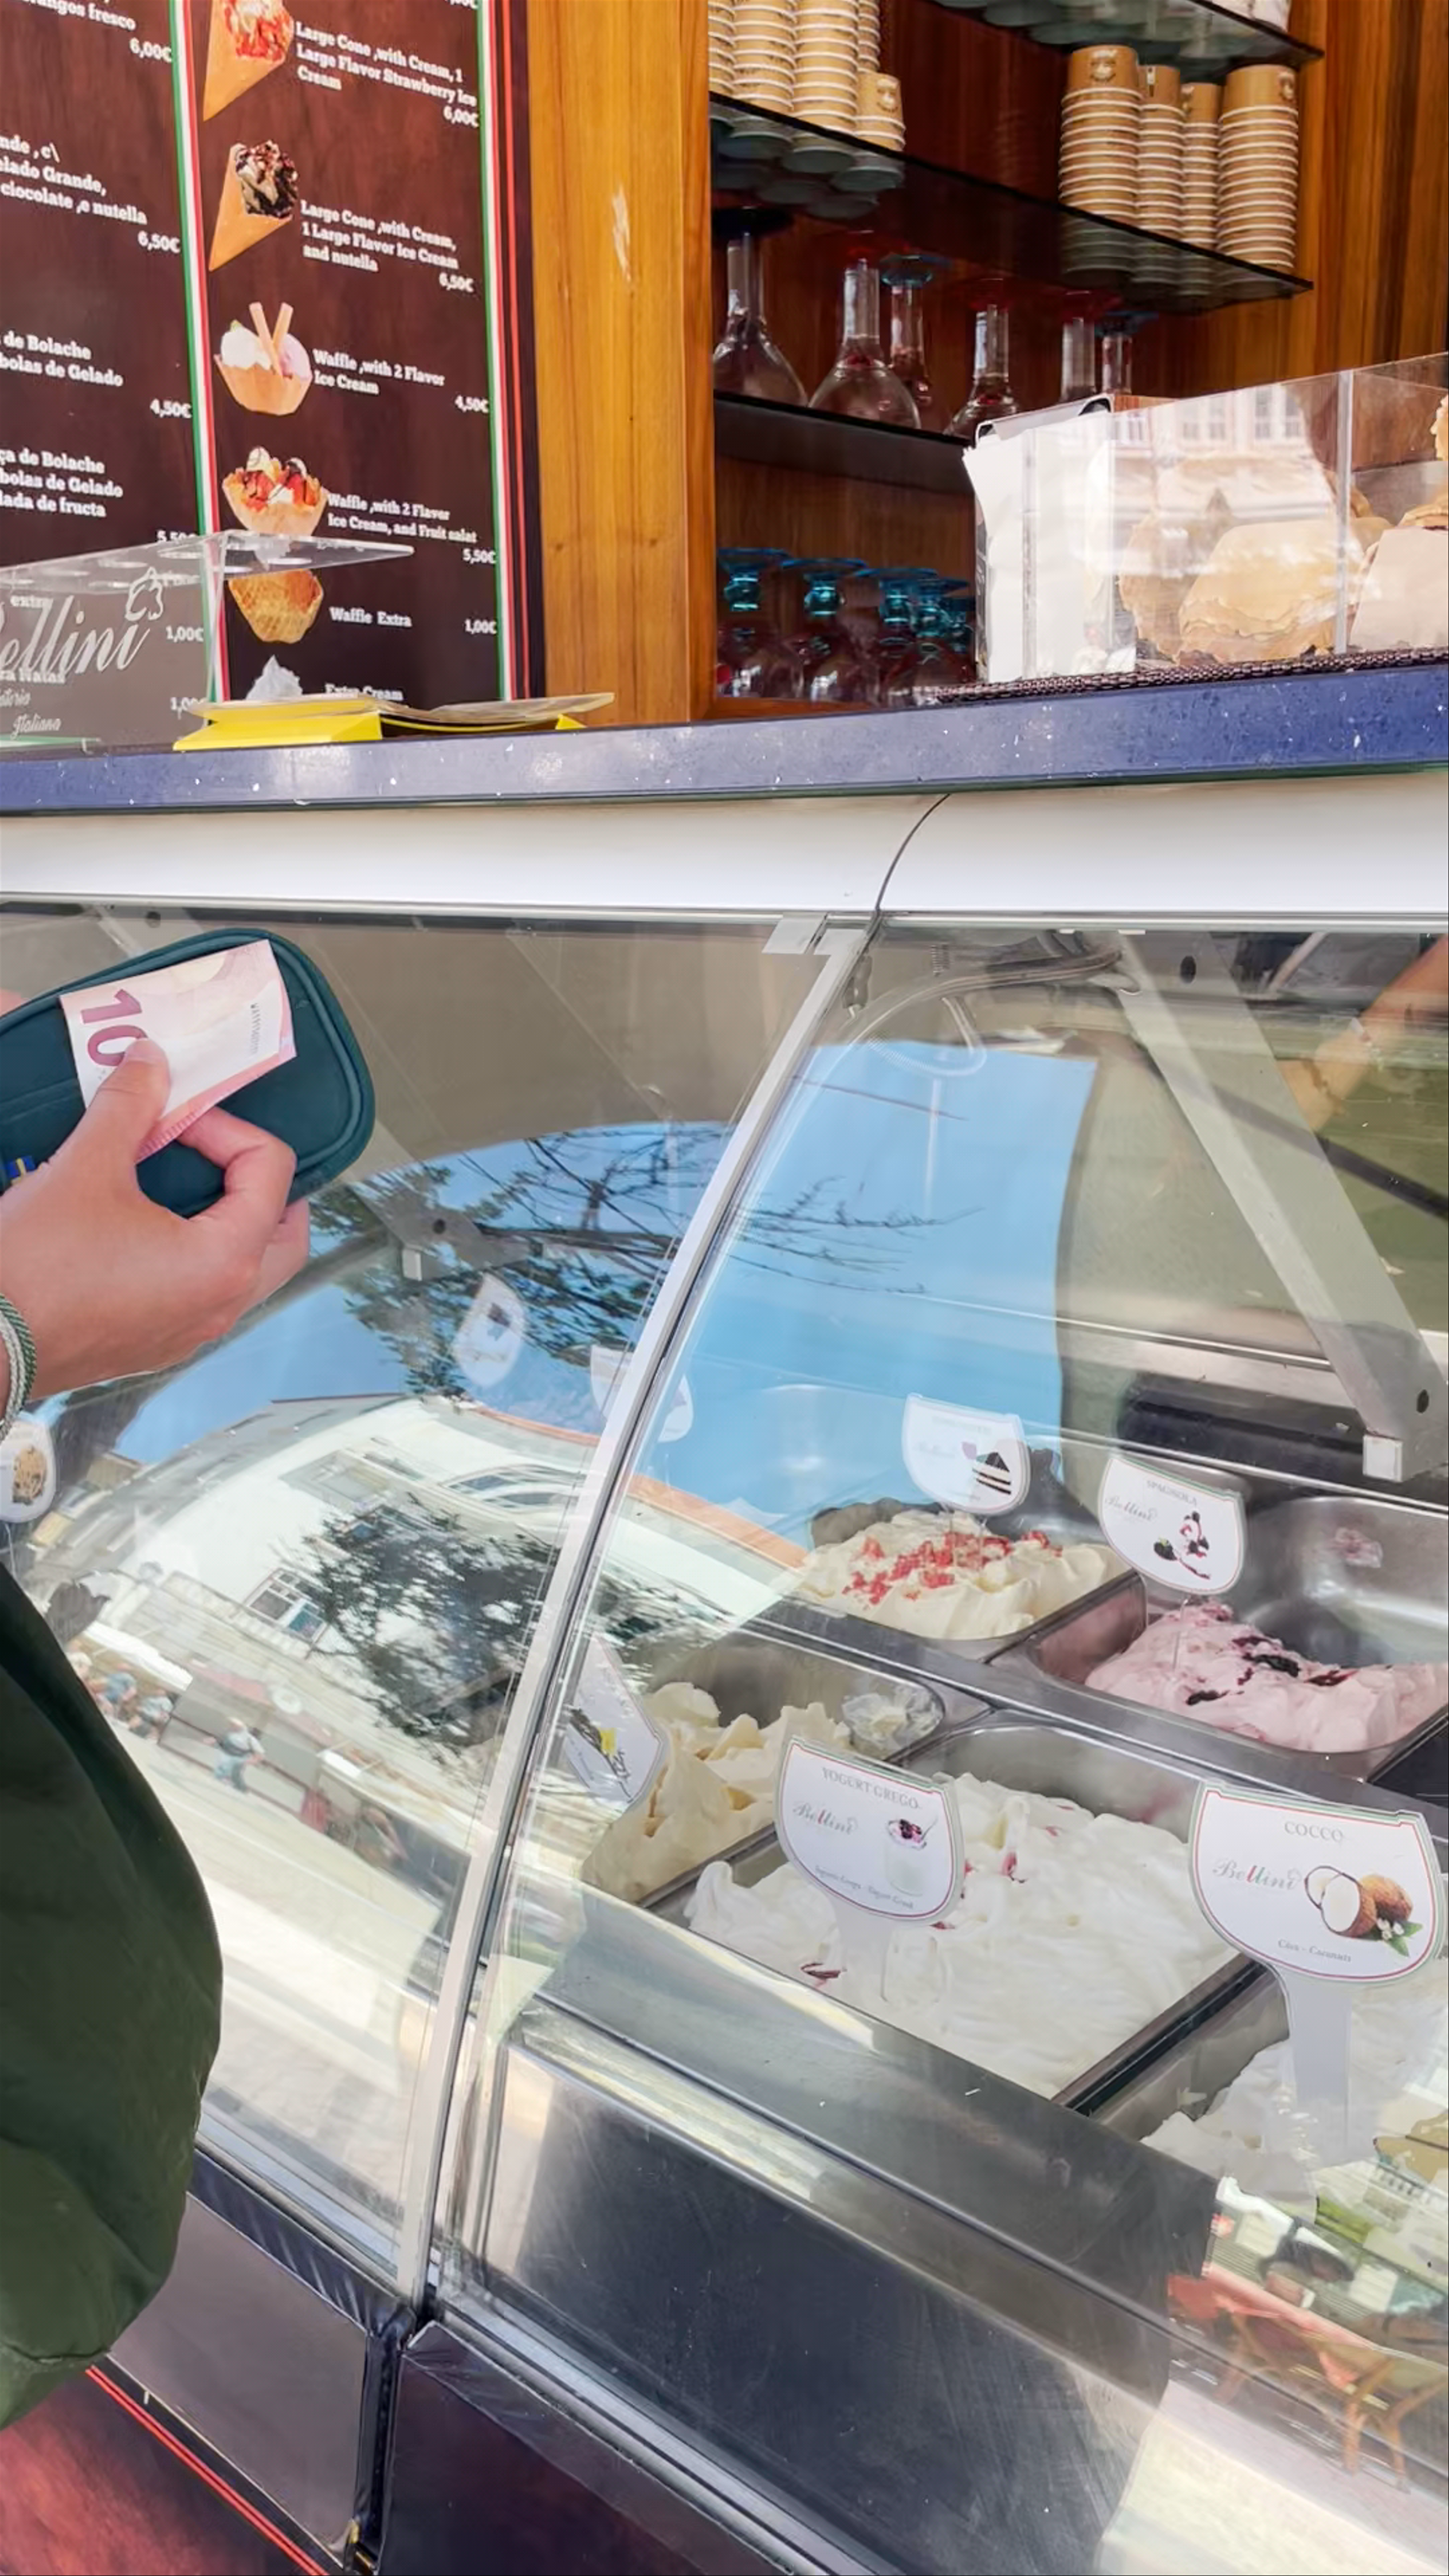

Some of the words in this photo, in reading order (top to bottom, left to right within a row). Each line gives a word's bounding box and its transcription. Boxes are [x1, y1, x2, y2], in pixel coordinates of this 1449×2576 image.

[88, 3, 136, 31] fresco
[129, 37, 172, 62] 6,00€
[296, 21, 335, 47] Large
[337, 35, 371, 56] Cone
[409, 56, 454, 82] Cream,
[456, 69, 463, 82] 1
[297, 43, 336, 68] Large
[338, 55, 382, 80] Flavor
[383, 68, 455, 103] Strawberry
[457, 88, 477, 106] Ice
[297, 65, 342, 91] Cream
[443, 106, 478, 127] 6,00€
[43, 166, 106, 197] Grande,
[0, 180, 73, 209] ciocolate
[92, 204, 148, 225] nutella
[301, 200, 340, 223] Large
[341, 209, 375, 231] Cone
[412, 226, 455, 251] Cream,
[138, 230, 180, 253] 6,50€
[303, 223, 310, 236] 1
[312, 223, 350, 246] Large
[353, 232, 395, 255] Flavor
[397, 244, 416, 260] Ice
[418, 249, 458, 269] Cream
[303, 244, 330, 261] and
[332, 252, 378, 272] nutella
[439, 272, 473, 292] 6,50€
[3, 331, 25, 348] de
[26, 335, 92, 360] Bolache
[0, 352, 43, 374] bolas
[45, 359, 65, 378] de
[68, 363, 123, 387] Gelado
[313, 349, 357, 371] Waffle
[394, 364, 403, 378] 2
[404, 366, 445, 386] Flavor
[314, 373, 335, 388] Ice
[337, 376, 379, 395] Cream
[151, 398, 192, 418] 4,50€
[455, 395, 489, 413] 4,50€
[18, 448, 39, 466] de
[41, 451, 105, 474] Bolache
[0, 467, 43, 488] bolas
[46, 473, 66, 491] de
[68, 476, 123, 498] Gelado
[36, 494, 57, 512] de
[59, 496, 107, 518] fructa
[328, 493, 368, 511] Waffle
[402, 502, 411, 514] 2
[412, 502, 450, 520] Flavor
[328, 512, 348, 528] Ice
[349, 515, 392, 536] Cream,
[393, 522, 417, 537] and
[418, 524, 448, 540] Fruit
[463, 547, 496, 564] 5,50€
[329, 606, 372, 624] Waffle
[377, 611, 412, 627] Extra
[465, 618, 497, 635] 1,00€
[0, 595, 150, 674] ellini
[166, 625, 204, 643] 1,00€
[80, 989, 148, 1067] 10
[821, 1767, 870, 1793] YOGERT
[874, 1785, 919, 1809] GREGO
[1284, 1821, 1343, 1842] COCCO
[1213, 1858, 1297, 1890] Bellini
